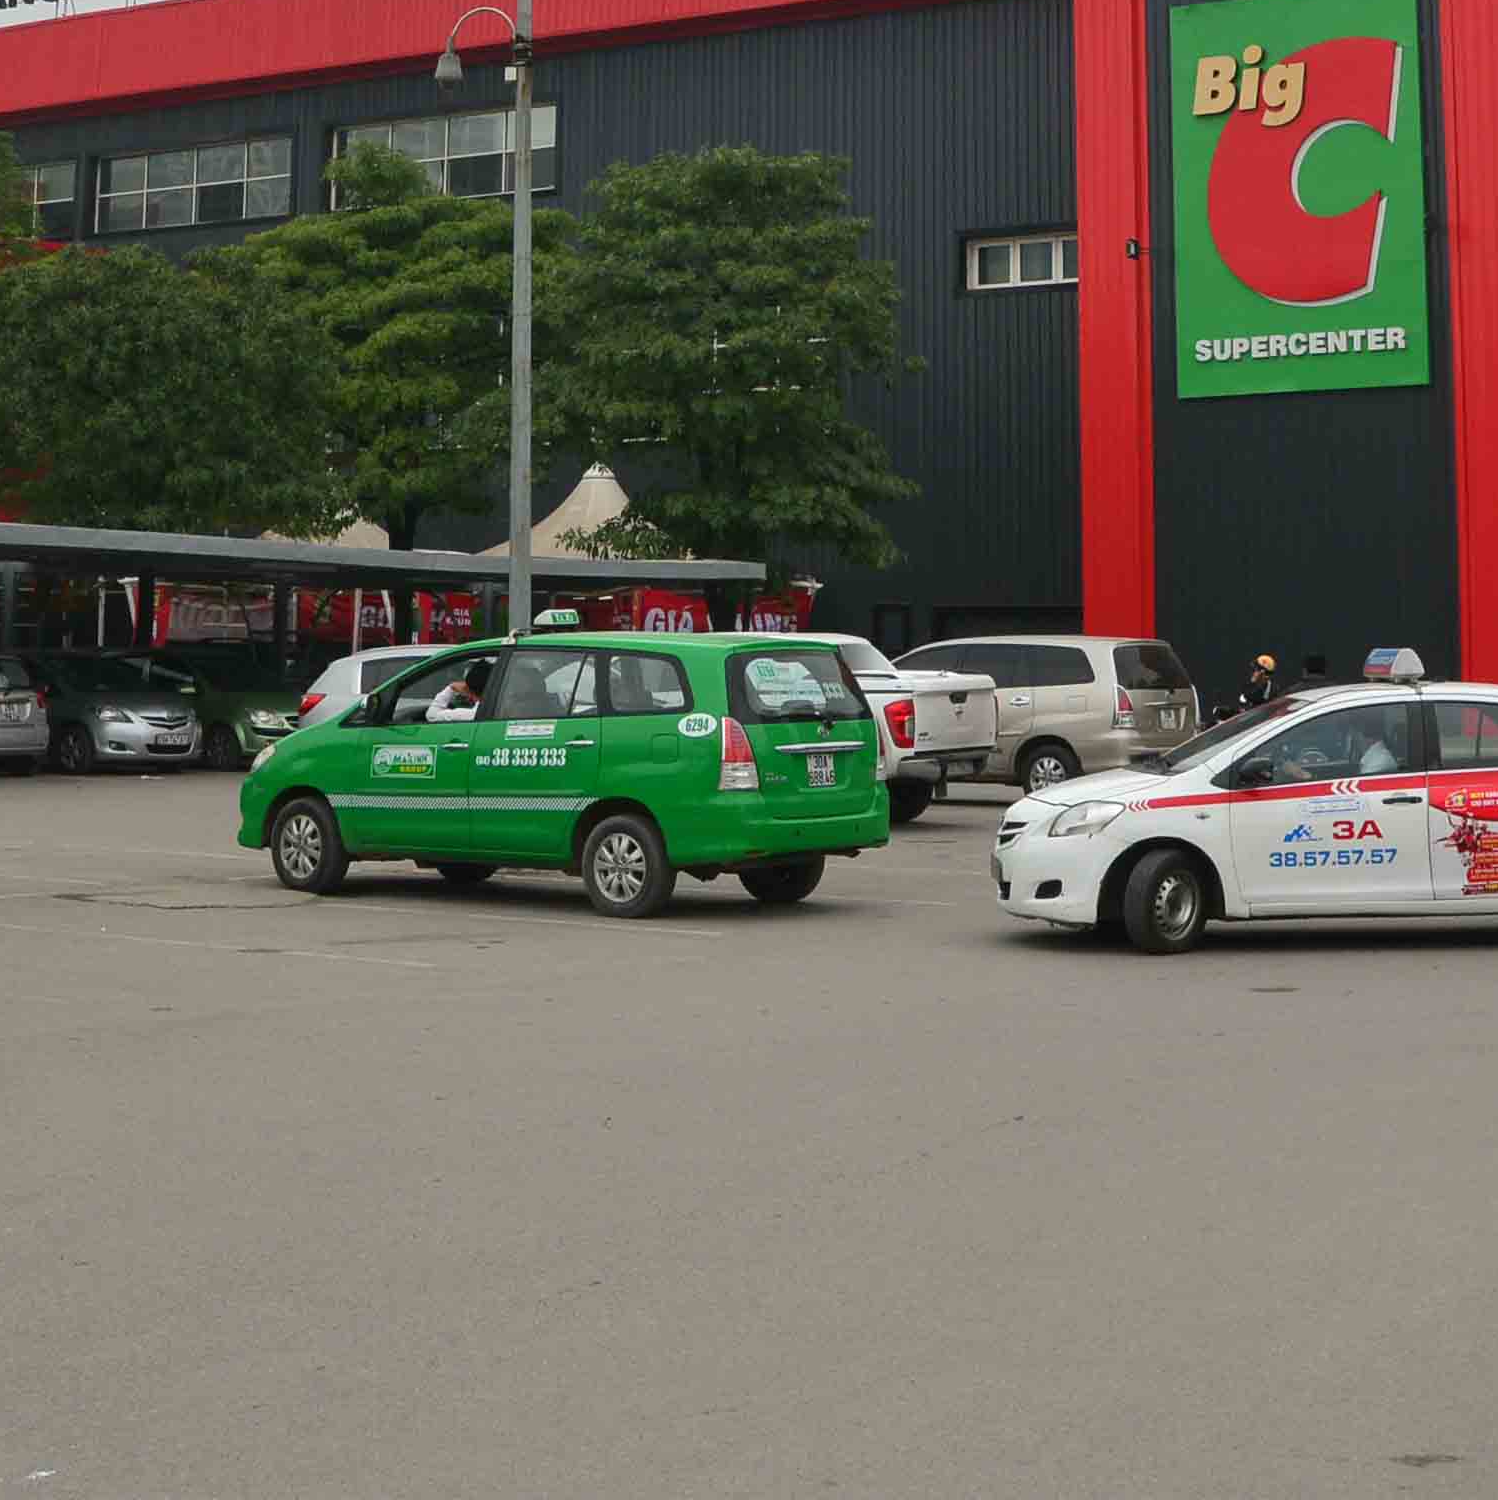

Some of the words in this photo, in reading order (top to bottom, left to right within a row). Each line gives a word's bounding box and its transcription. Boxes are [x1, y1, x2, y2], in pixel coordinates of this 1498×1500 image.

[1192, 44, 1305, 127] Big
[1207, 36, 1403, 307] C
[1195, 327, 1406, 362] SUPERCENTER
[492, 747, 510, 766] 38
[512, 747, 538, 766] 333
[540, 747, 567, 766] 333
[1332, 819, 1383, 840] 3A
[1269, 848, 1398, 868] 38.57.57.57
